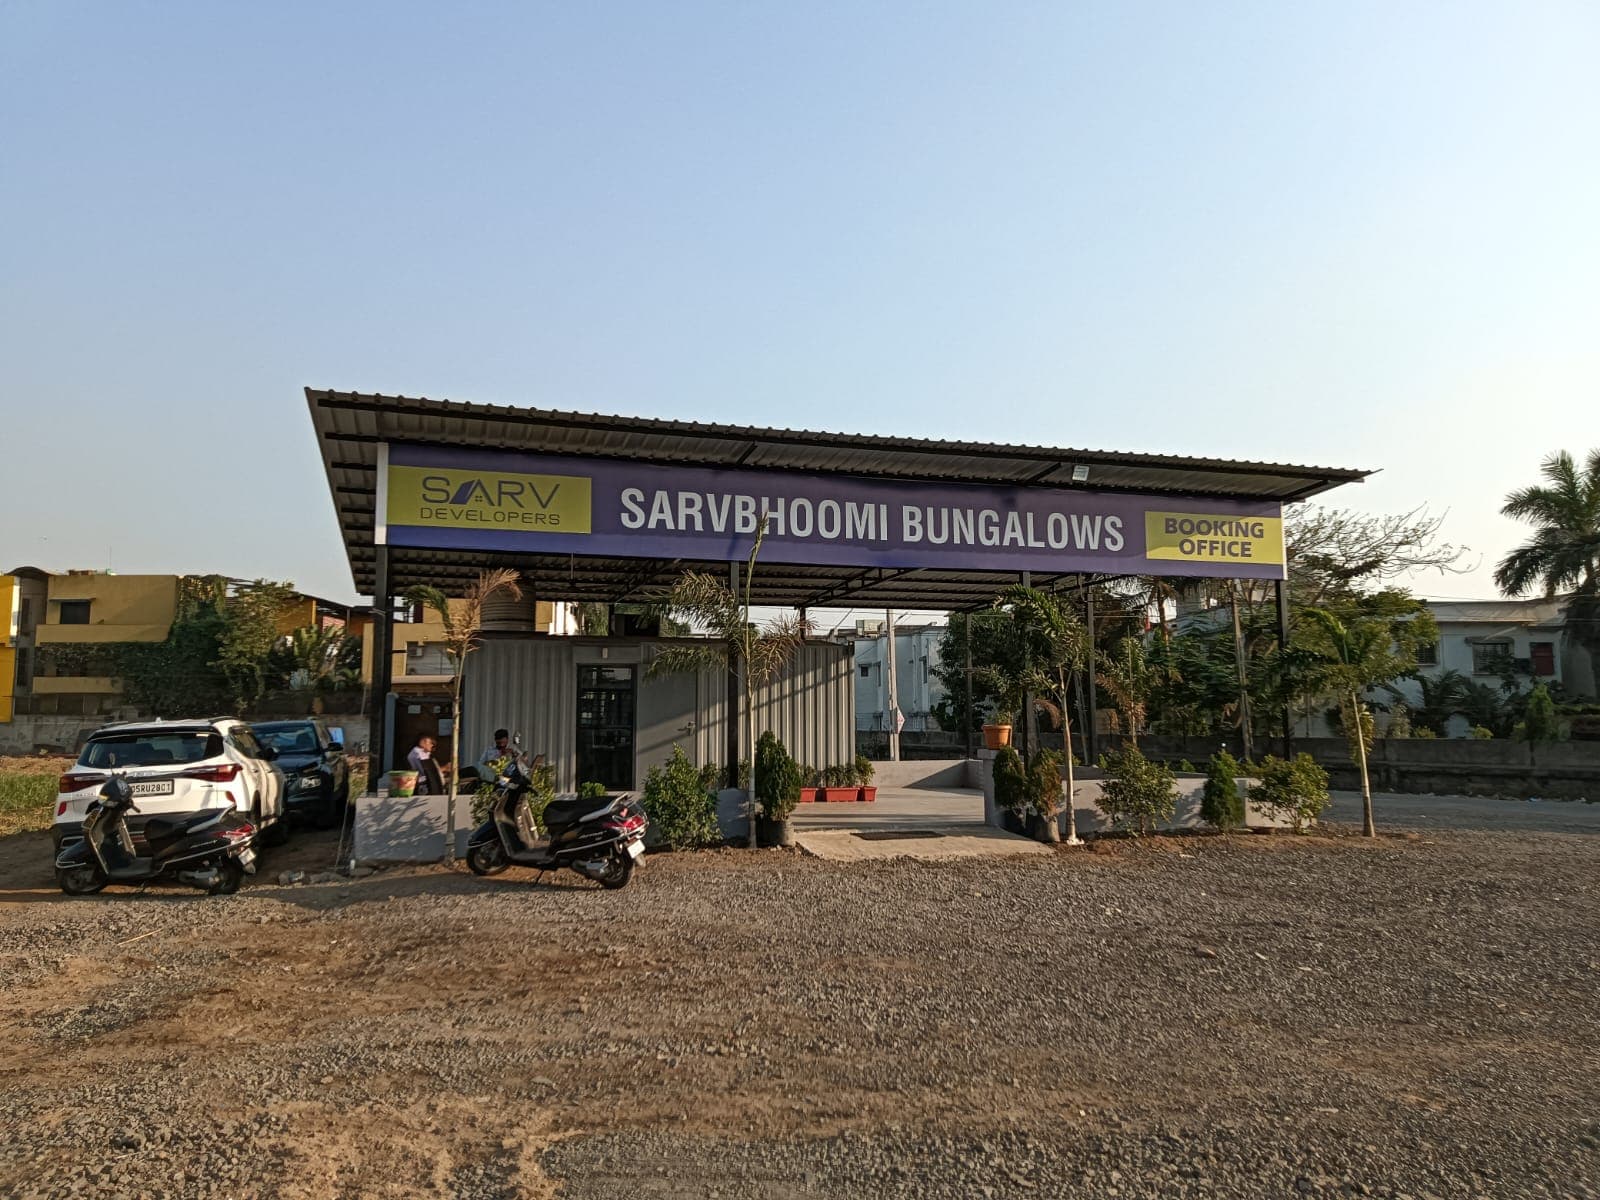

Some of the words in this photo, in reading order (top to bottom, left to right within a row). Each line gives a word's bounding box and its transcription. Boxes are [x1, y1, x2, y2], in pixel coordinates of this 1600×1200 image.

[422, 476, 561, 509] SARV
[420, 507, 561, 526] DEVELOPERS
[620, 487, 888, 541] SARVBHOOMI
[902, 505, 1125, 552] BUNGALOWS
[1164, 517, 1264, 539] BOOKING
[1179, 538, 1252, 558] OFFICE
